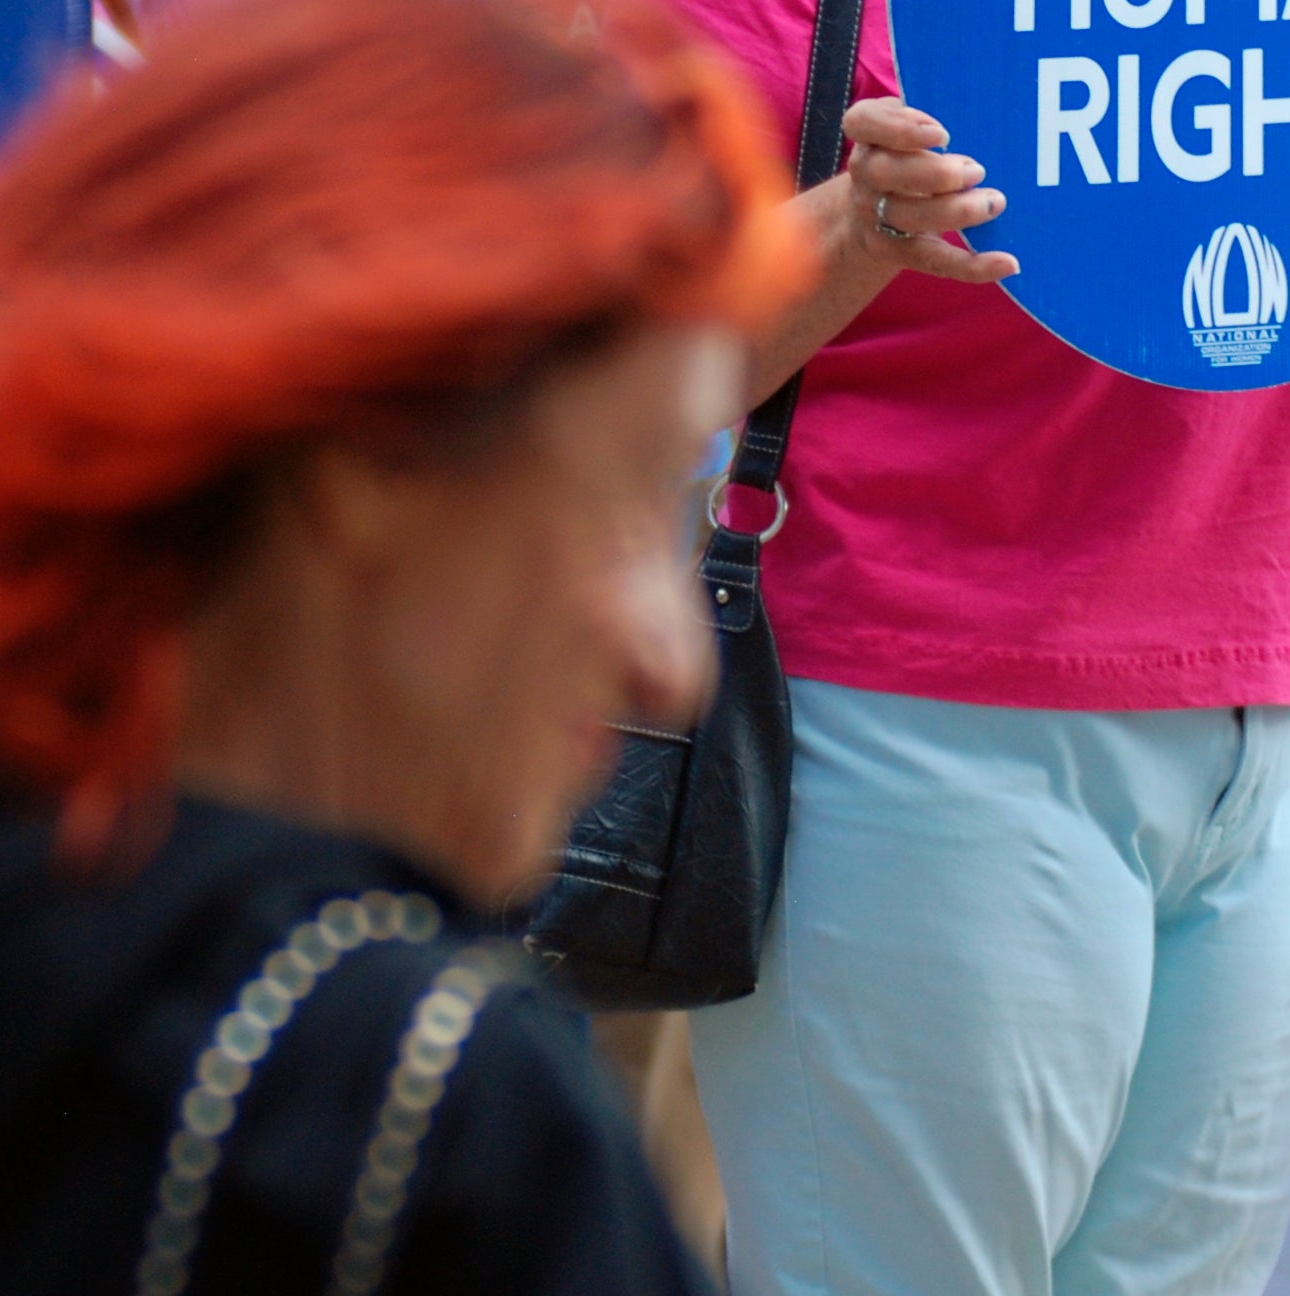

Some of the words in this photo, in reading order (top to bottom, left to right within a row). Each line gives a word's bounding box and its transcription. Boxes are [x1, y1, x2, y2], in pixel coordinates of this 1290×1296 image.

[1182, 222, 1289, 329] NOW
[1192, 329, 1278, 344] NATIONAL
[1201, 343, 1271, 355] ORGANIZATION
[1211, 356, 1228, 364] FOR
